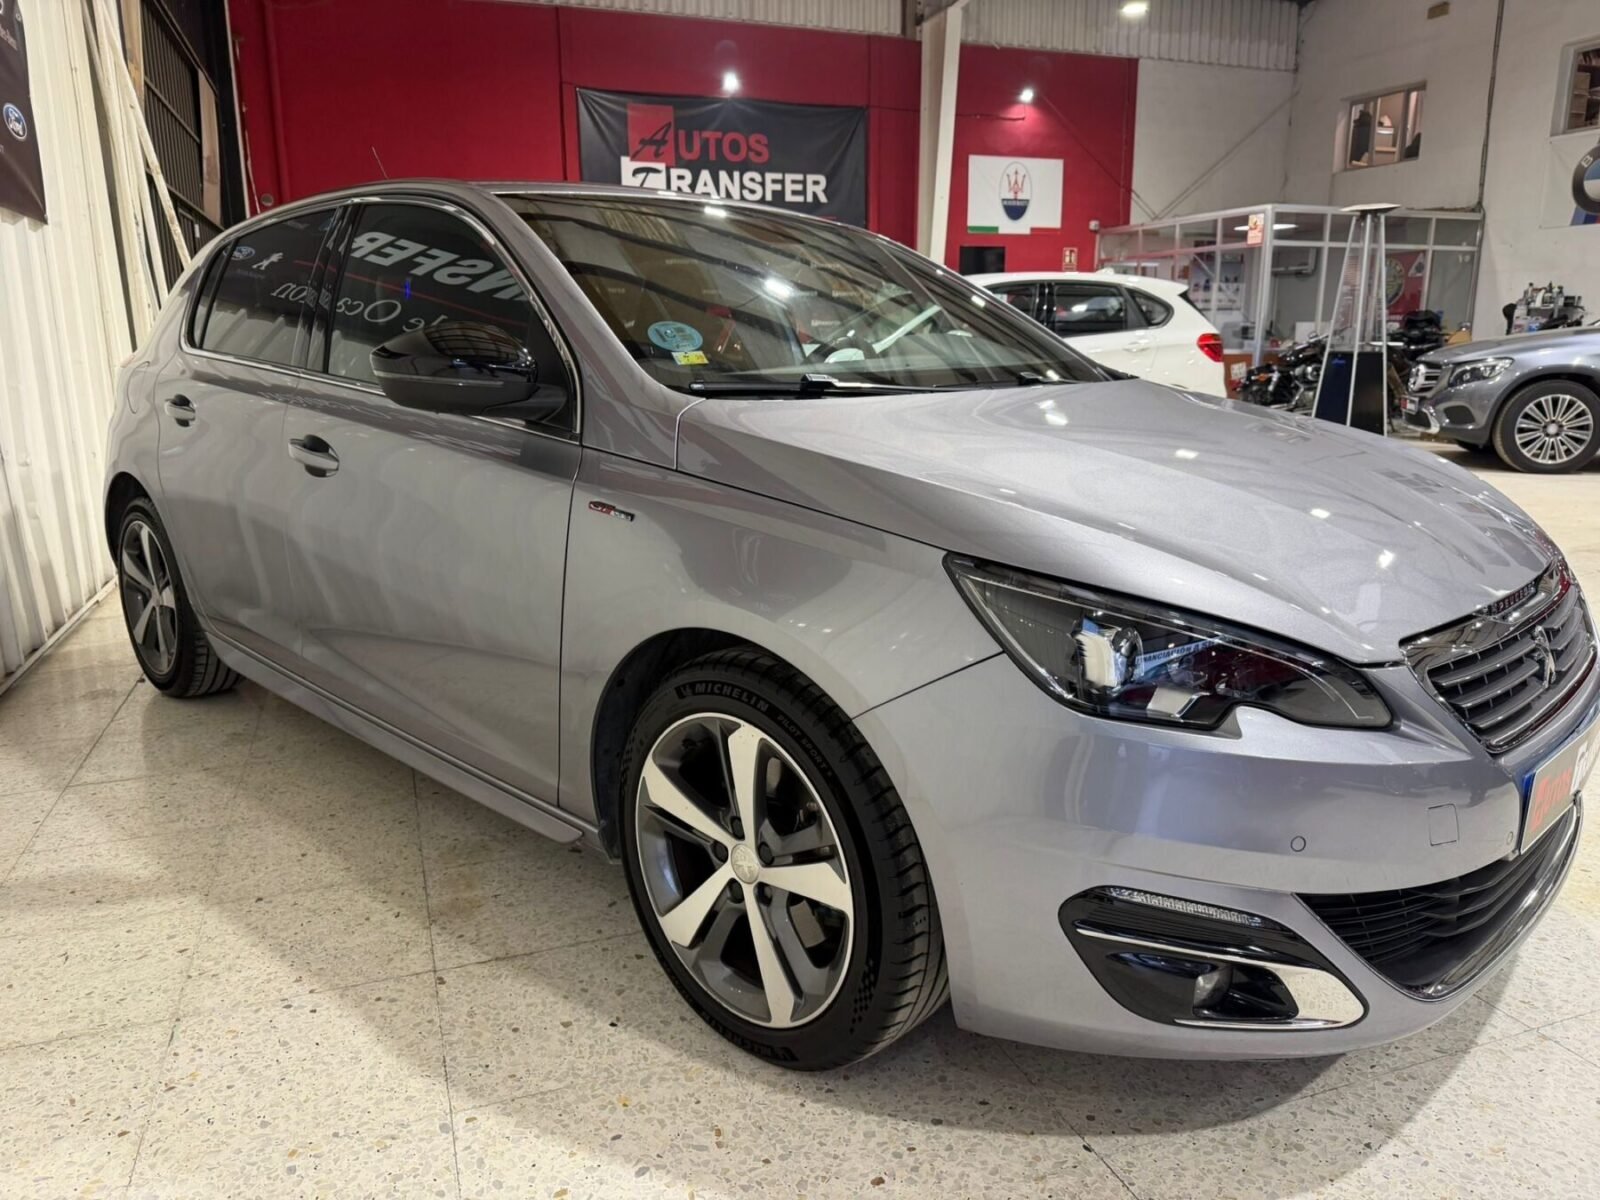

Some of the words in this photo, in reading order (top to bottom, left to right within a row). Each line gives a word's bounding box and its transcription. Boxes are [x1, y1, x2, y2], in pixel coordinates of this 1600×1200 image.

[630, 121, 770, 164] AUTOS
[627, 163, 828, 203] TRANSFER
[694, 682, 770, 713] MICHELIN
[776, 713, 802, 738] PILOT
[801, 737, 827, 770] SPORT
